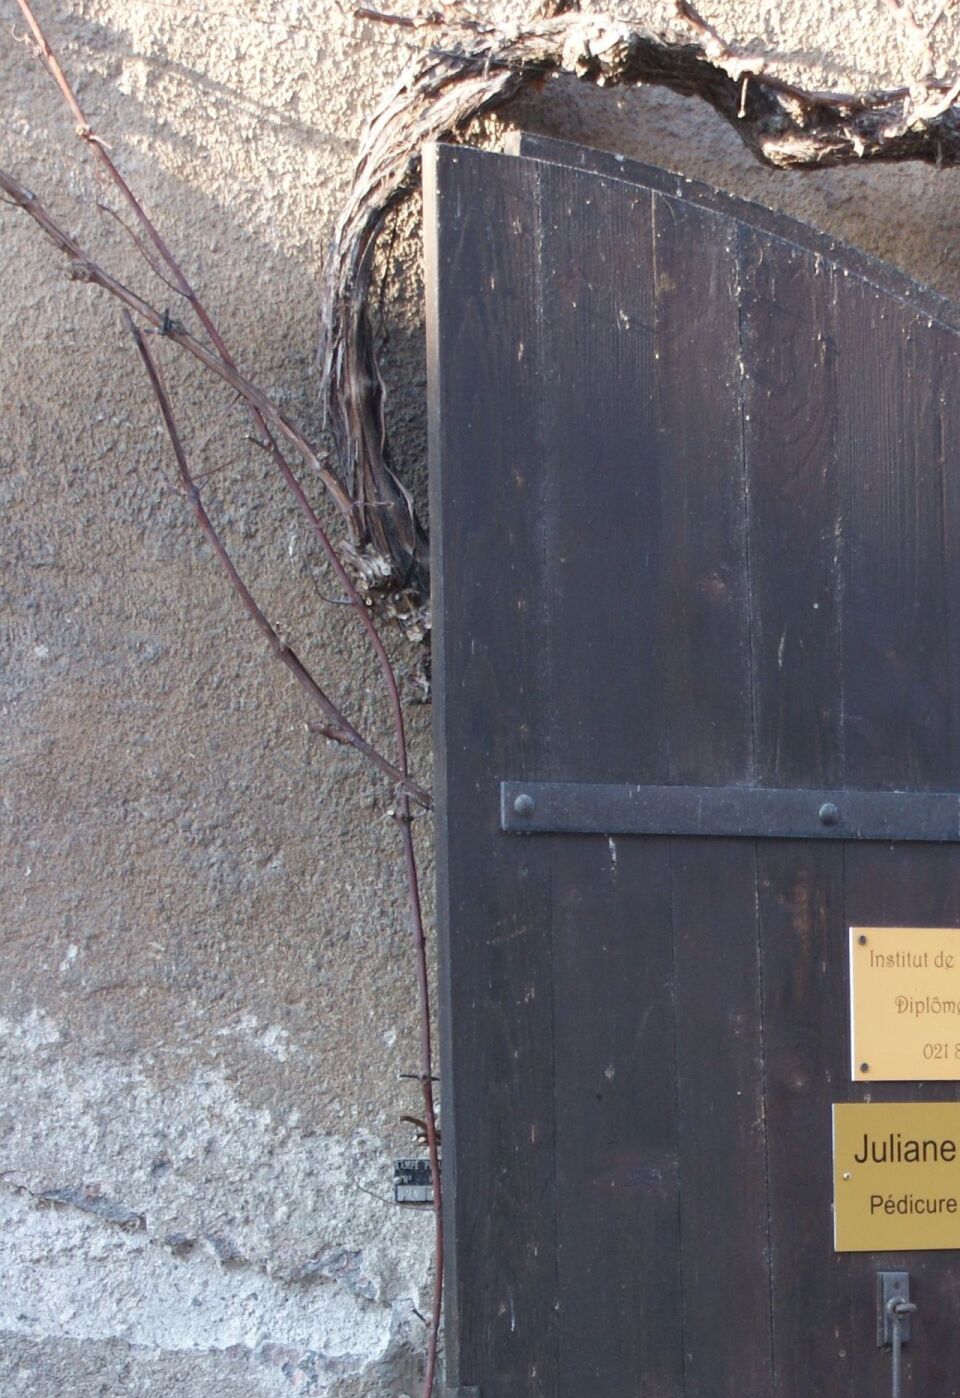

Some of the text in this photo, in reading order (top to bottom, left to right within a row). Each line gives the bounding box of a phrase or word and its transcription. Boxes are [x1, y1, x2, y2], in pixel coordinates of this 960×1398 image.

[870, 950, 928, 969] Institut
[934, 951, 953, 970] de
[923, 1043, 949, 1060] 021
[854, 1133, 956, 1164] Juliane
[870, 1194, 957, 1215] Pédicure
